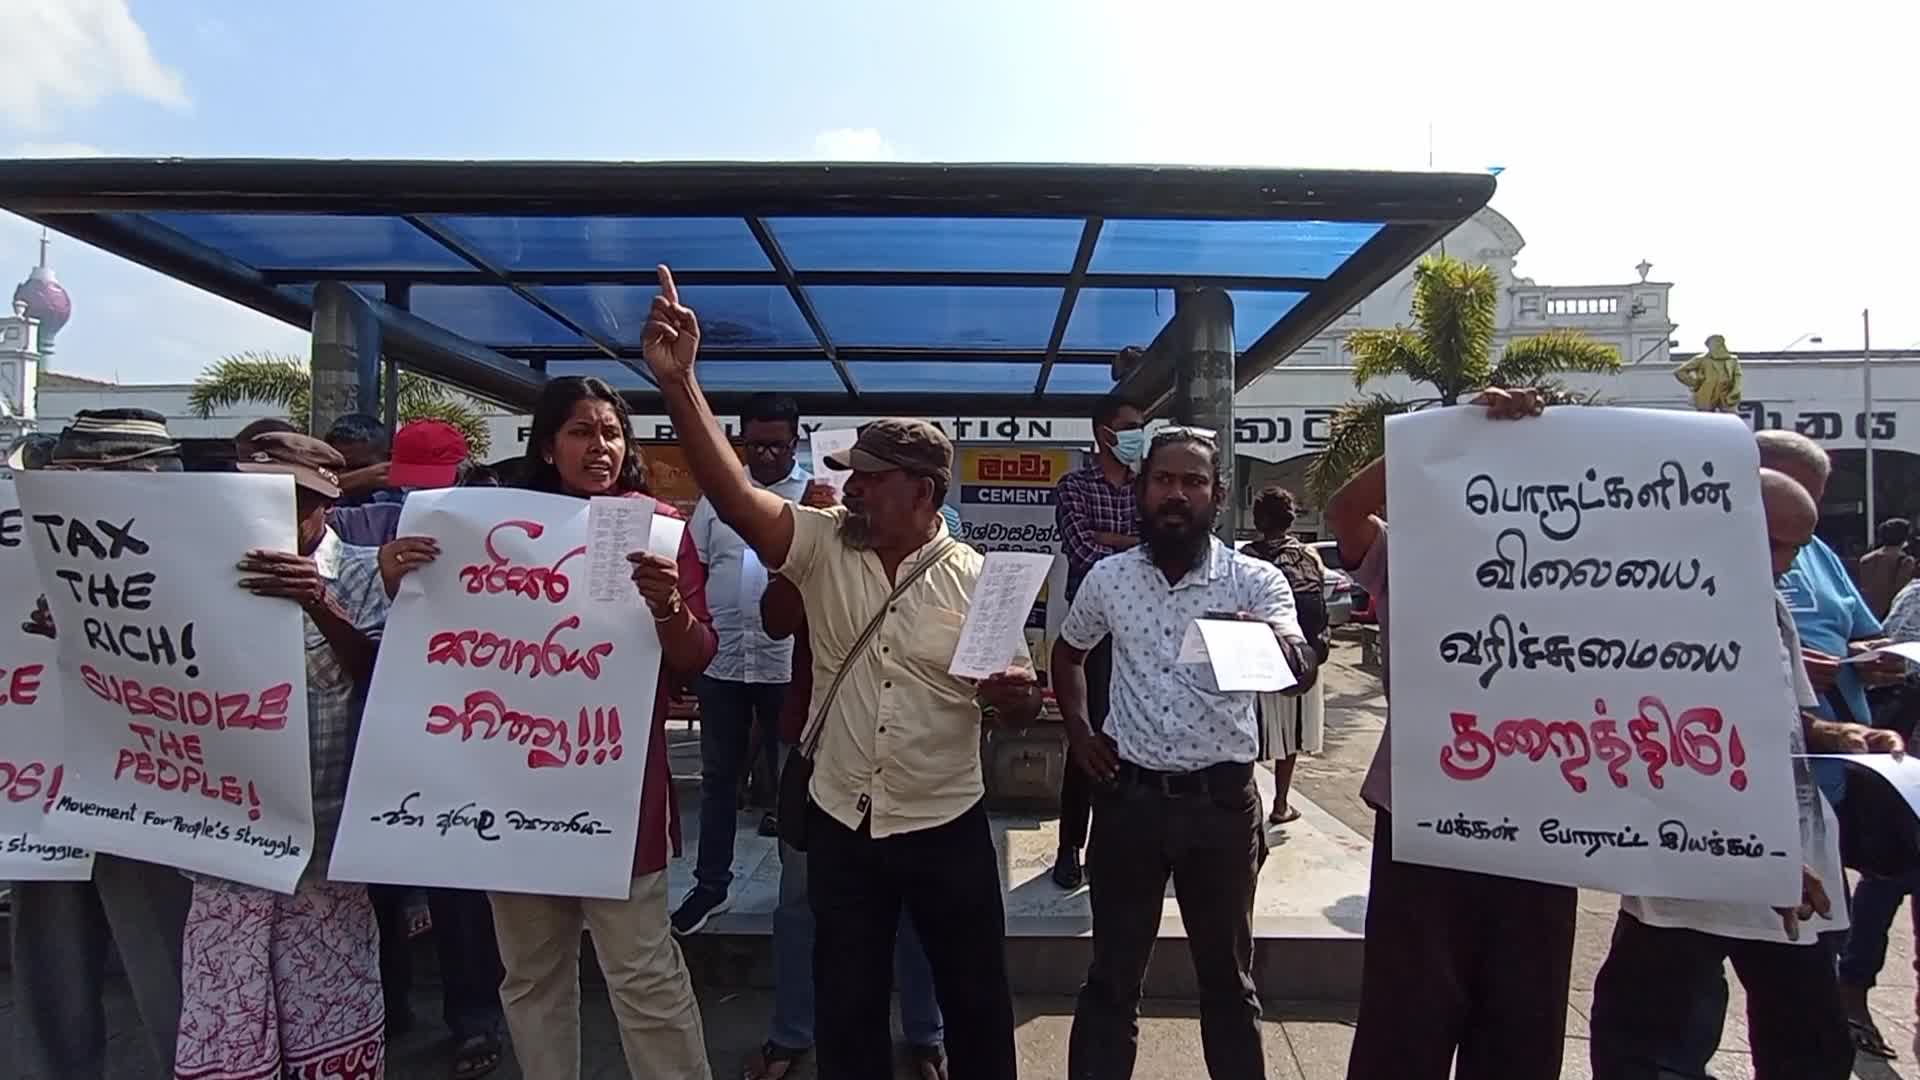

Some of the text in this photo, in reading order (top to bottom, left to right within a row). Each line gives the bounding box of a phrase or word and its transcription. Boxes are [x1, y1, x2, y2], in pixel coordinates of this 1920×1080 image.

[978, 488, 1051, 503] CEMENT
[1466, 461, 1732, 540] பொருட்களின்
[32, 513, 150, 560] TAX
[56, 570, 156, 609] THE
[84, 617, 199, 677] RICH!
[1440, 613, 1742, 689] வரிச்சுமையை
[80, 664, 293, 730] SUBSIDIZE
[128, 722, 204, 765] THE
[56, 795, 137, 822] Movement
[143, 811, 170, 826] For
[114, 748, 261, 821] PEOPLE!
